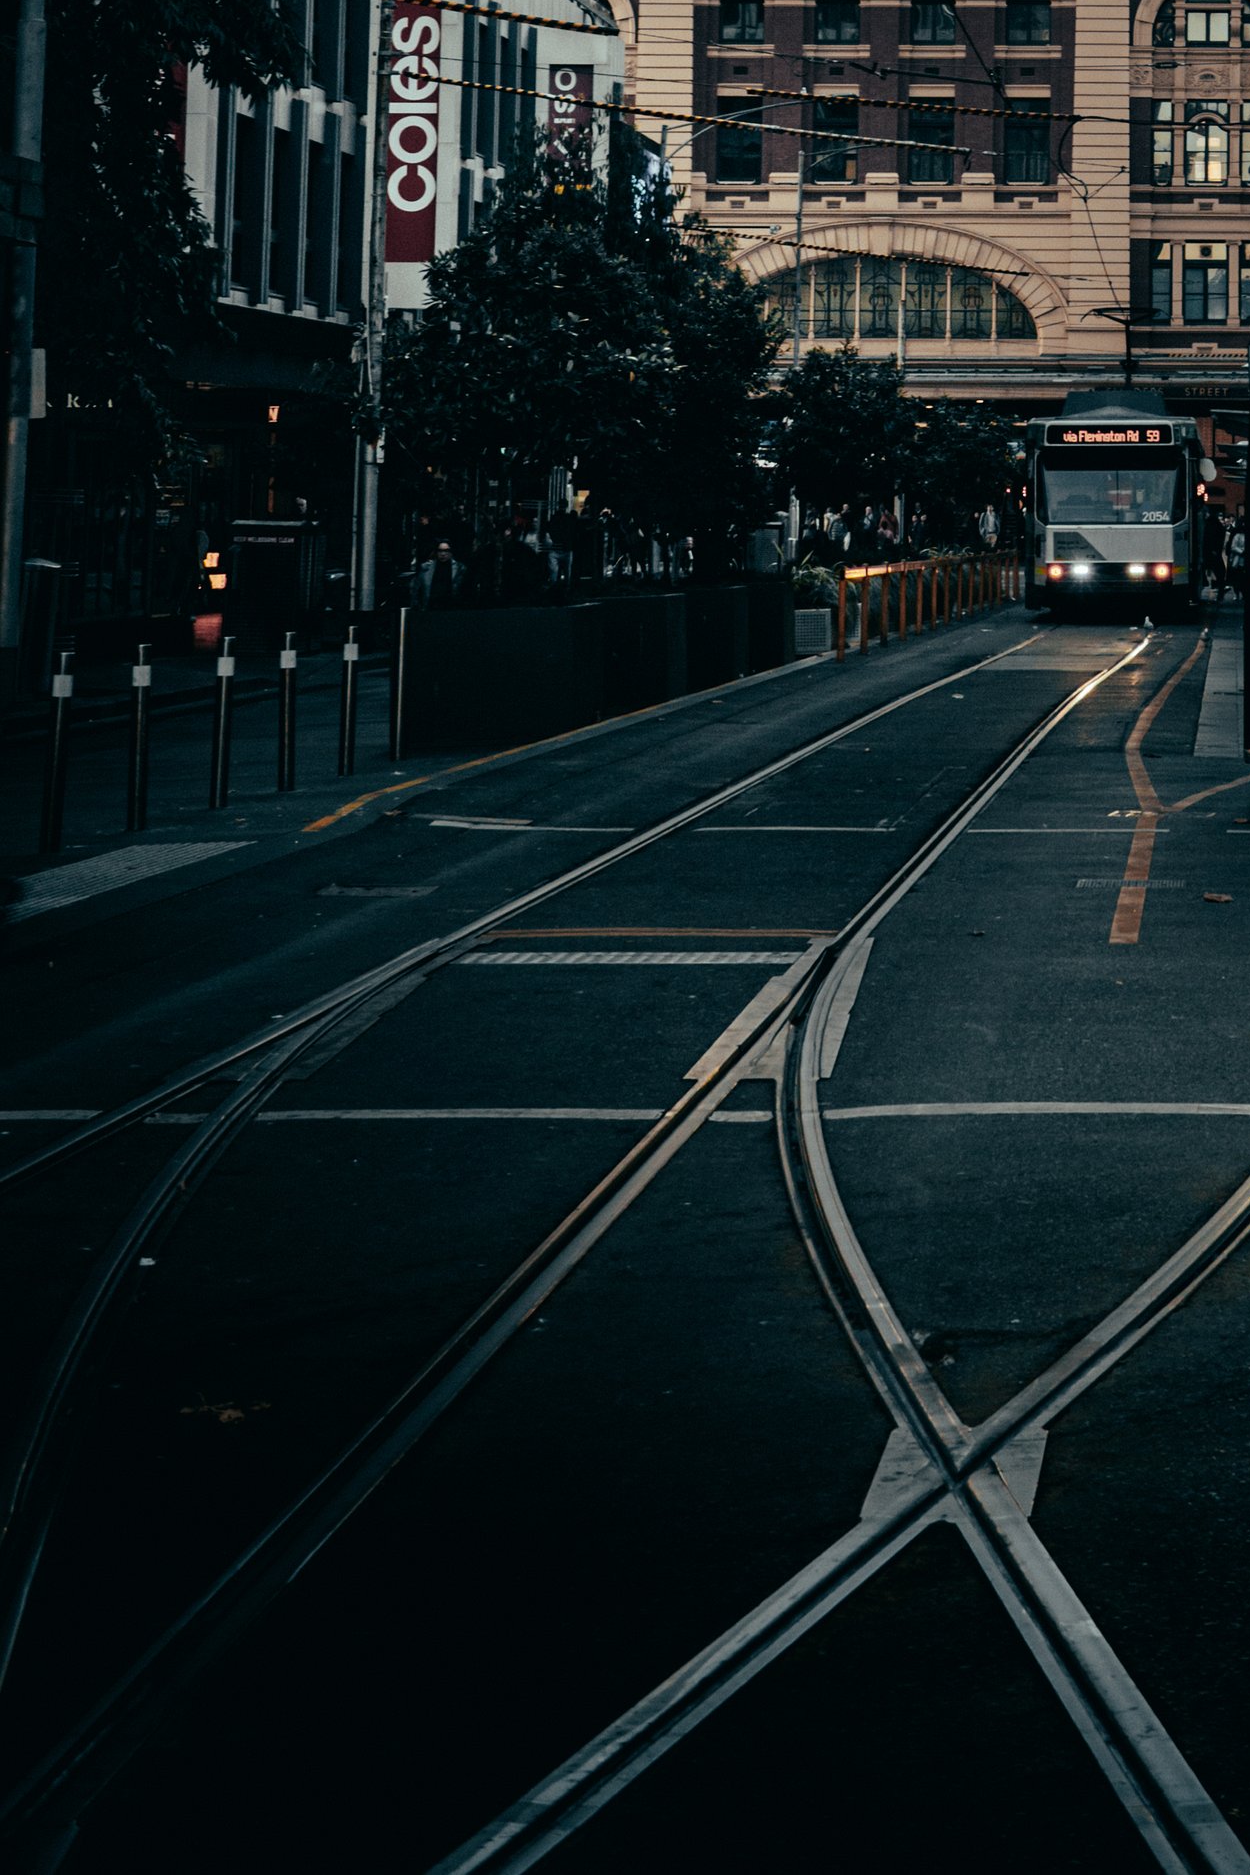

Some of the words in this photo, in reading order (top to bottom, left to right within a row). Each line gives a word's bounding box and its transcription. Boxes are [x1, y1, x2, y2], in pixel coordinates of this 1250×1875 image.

[387, 15, 441, 212] coles
[1185, 387, 1229, 397] STREET
[1146, 430, 1160, 443] 59
[1142, 511, 1170, 523] 2054
